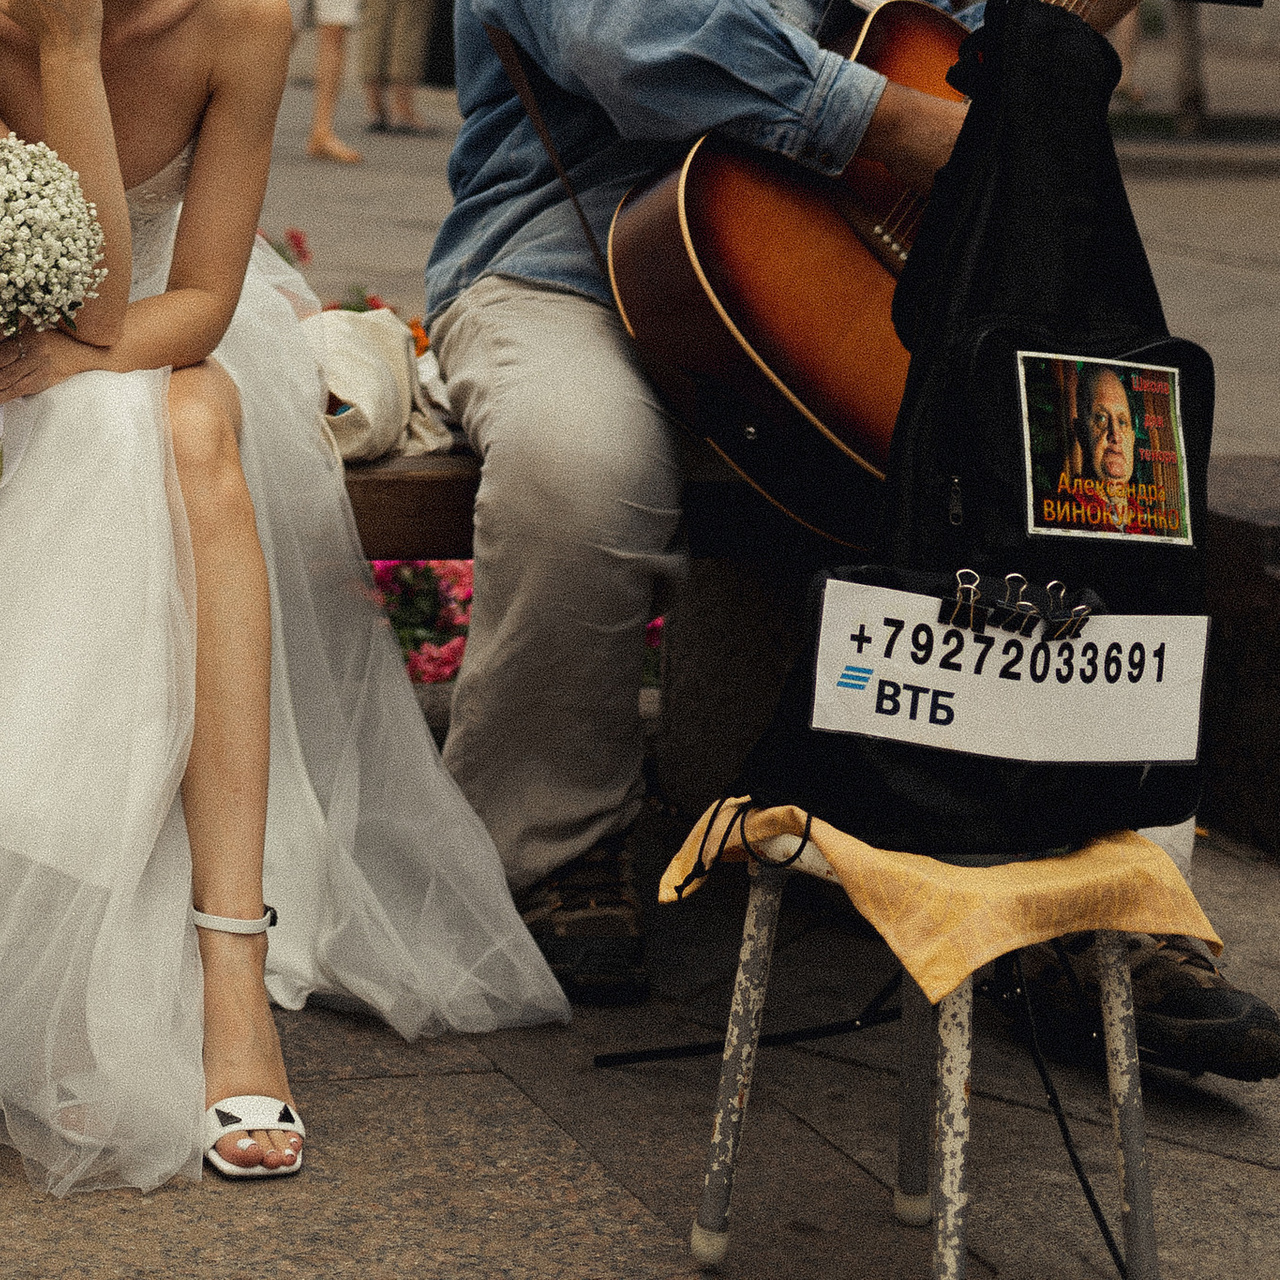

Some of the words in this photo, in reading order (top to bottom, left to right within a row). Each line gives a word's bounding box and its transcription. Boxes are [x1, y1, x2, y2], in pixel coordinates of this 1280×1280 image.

[1131, 375, 1170, 395] Школа
[1139, 448, 1177, 464] тенора
[1057, 472, 1166, 506] Александра
[1043, 499, 1180, 530] ВИНОКУРЕНКО
[850, 617, 1166, 685] +79272033691
[874, 678, 956, 727] ВТБ
